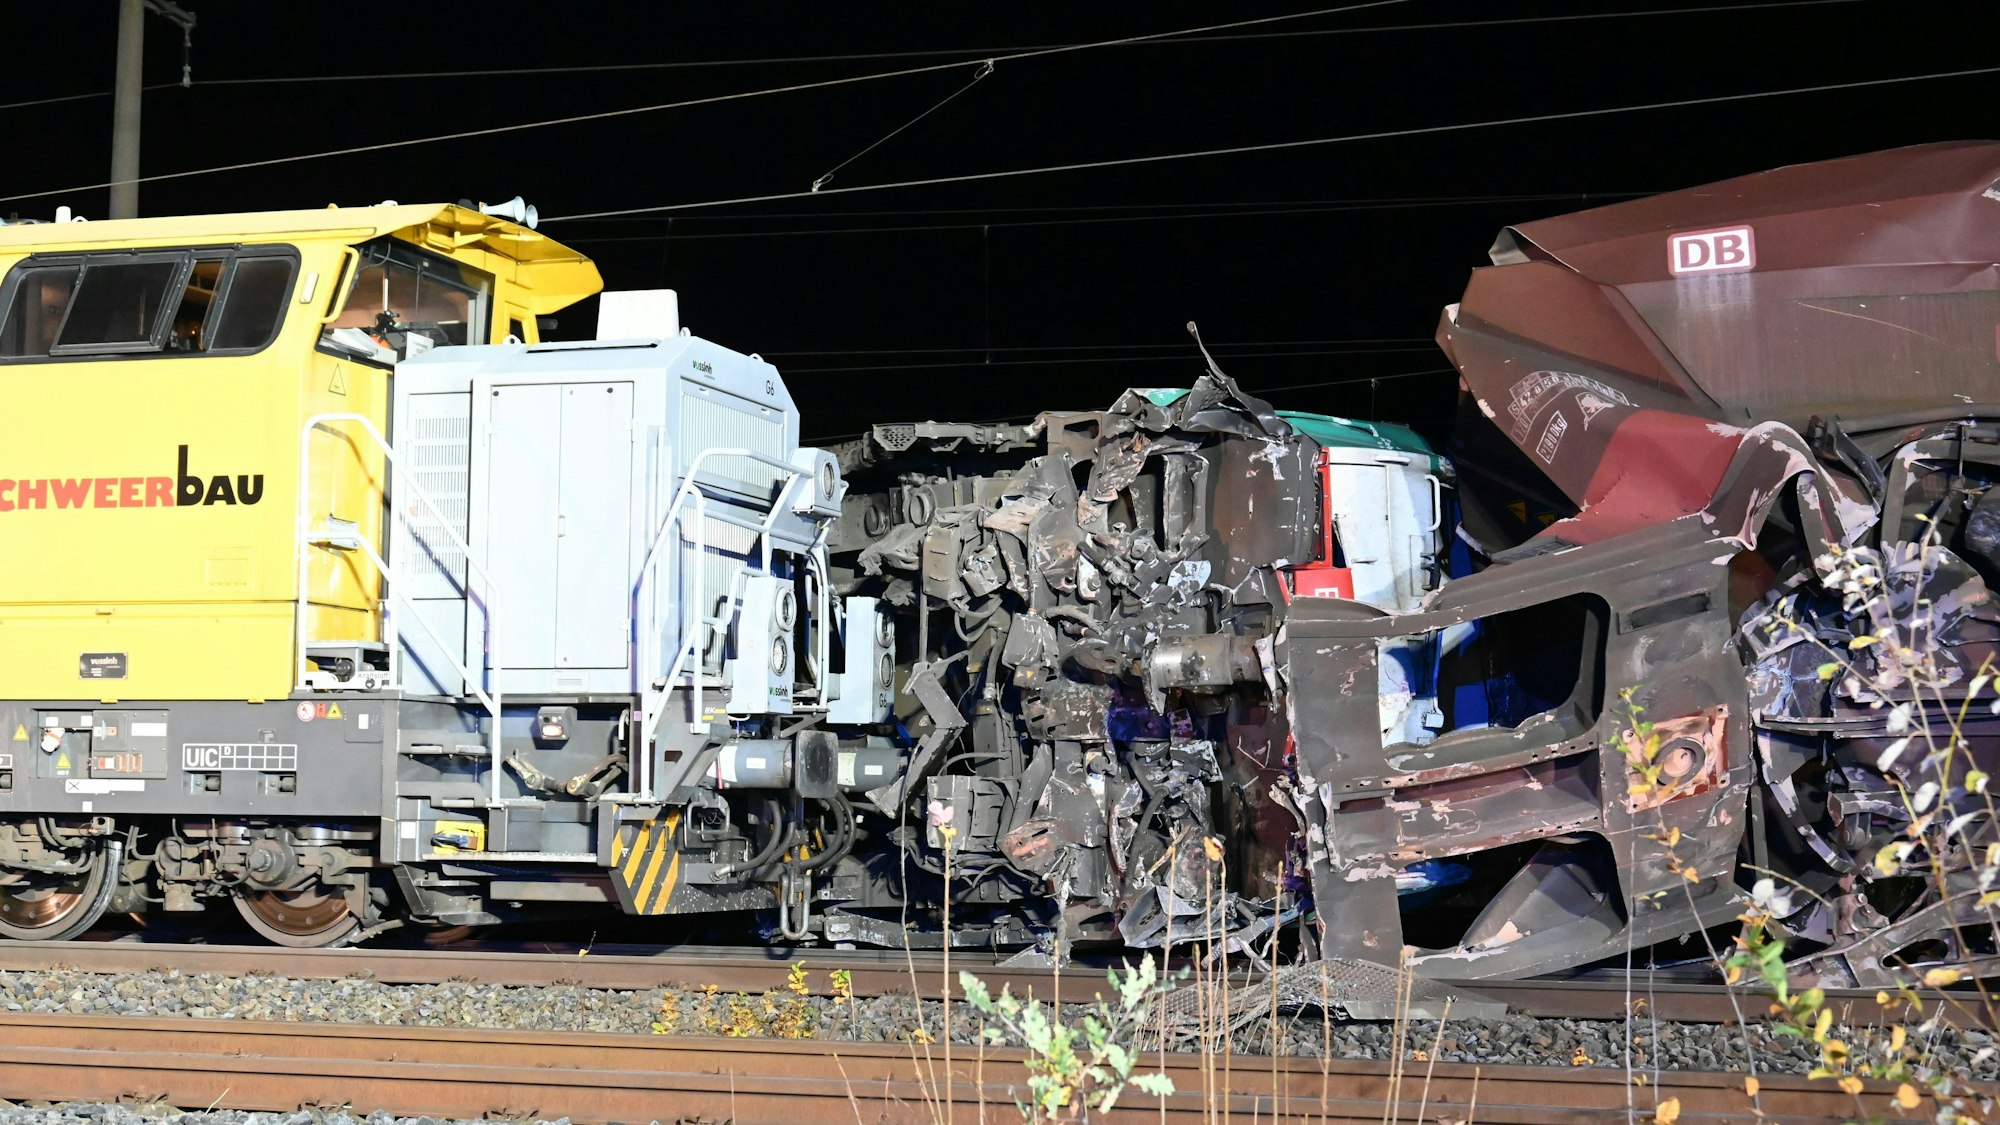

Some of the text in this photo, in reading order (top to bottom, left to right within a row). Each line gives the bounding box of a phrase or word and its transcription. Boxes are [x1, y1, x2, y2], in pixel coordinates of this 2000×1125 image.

[1679, 234, 1745, 268] DB
[766, 380, 775, 396] G6
[879, 693, 887, 708] G6
[186, 746, 231, 767] UIC D
